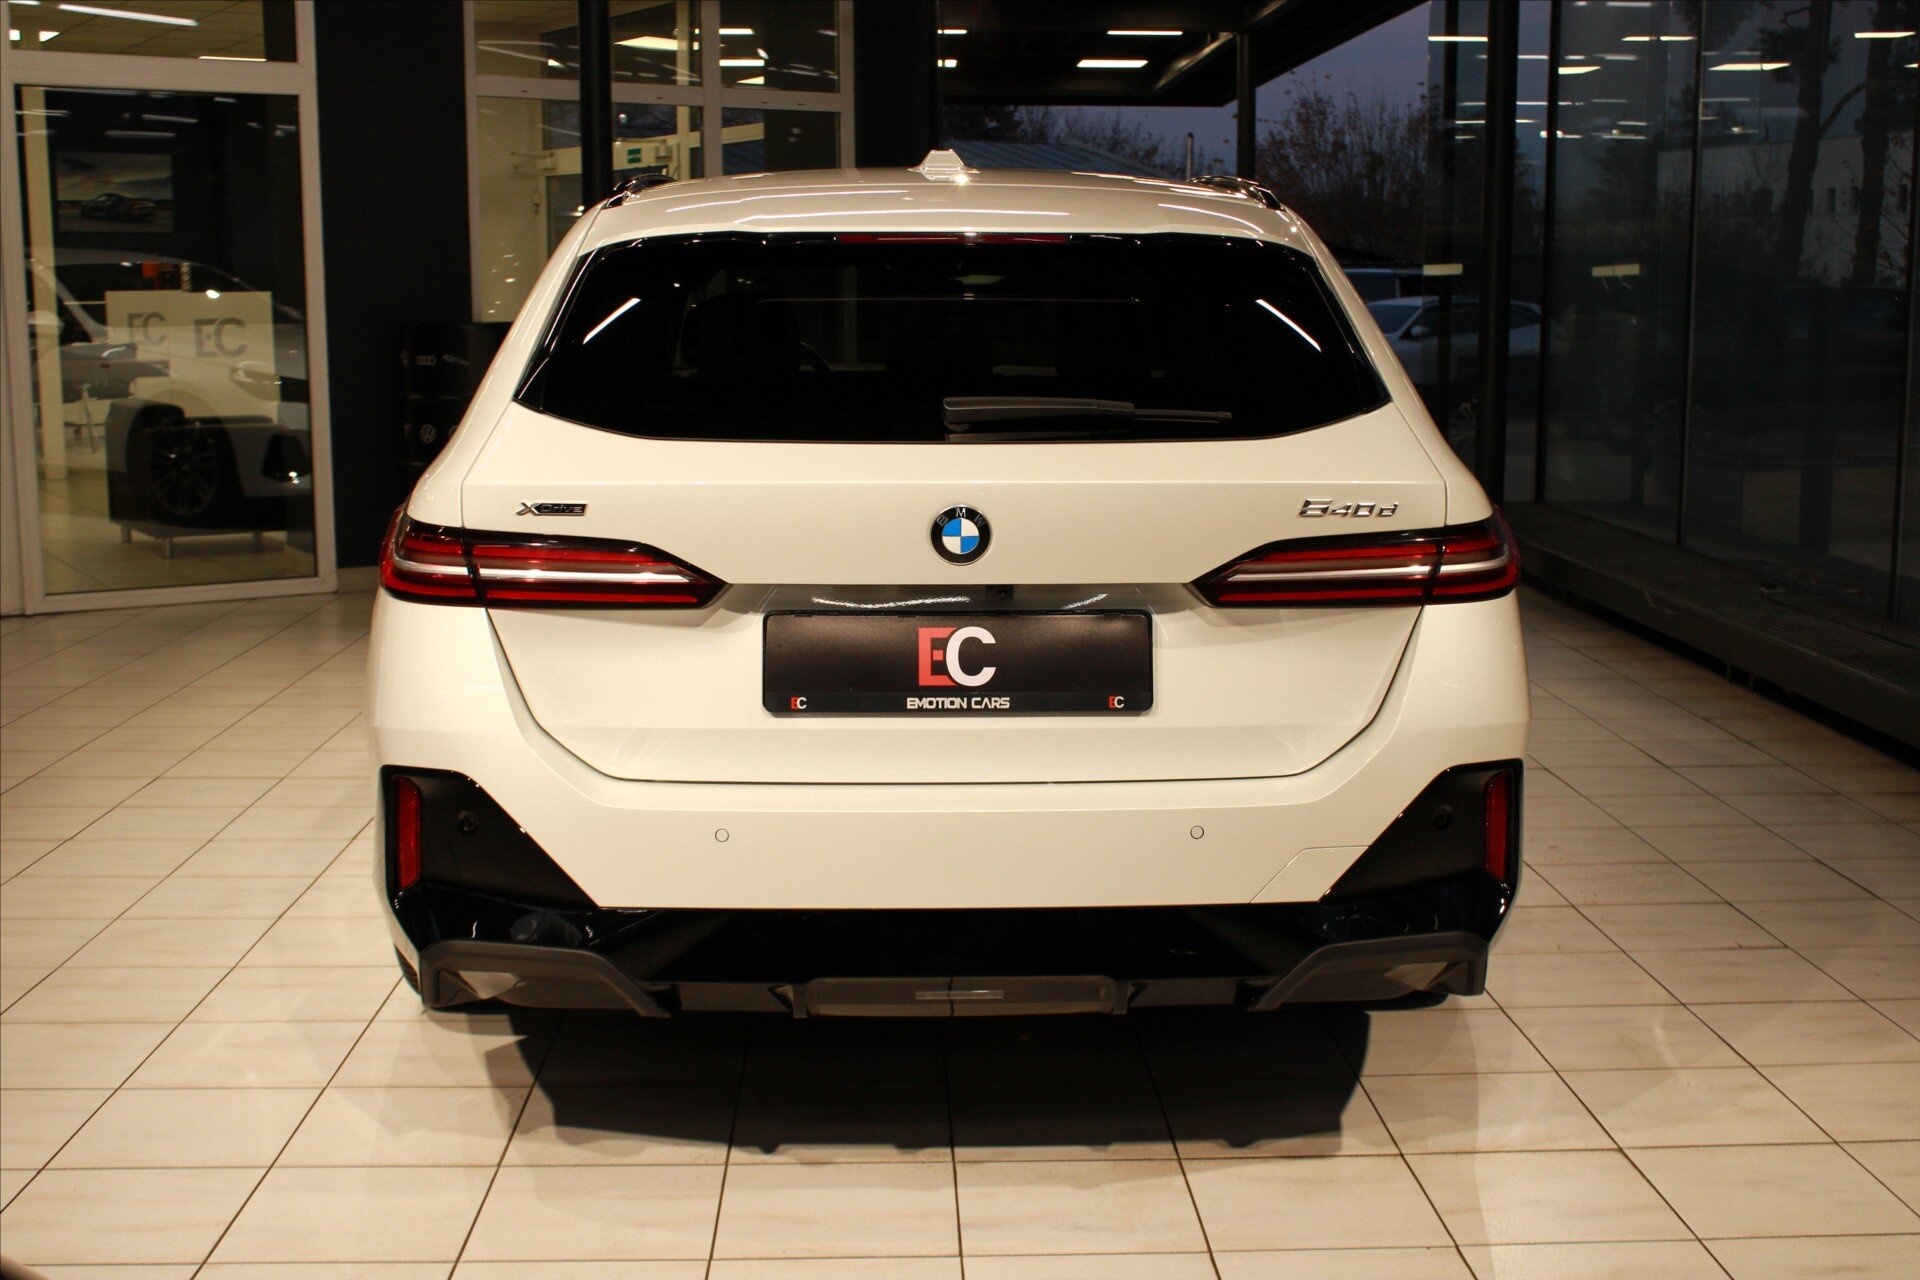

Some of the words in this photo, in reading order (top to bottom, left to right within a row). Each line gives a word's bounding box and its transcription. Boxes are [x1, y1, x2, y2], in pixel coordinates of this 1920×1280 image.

[194, 317, 248, 358] EC
[1298, 498, 1399, 517] 540d
[918, 626, 996, 686] EC
[791, 697, 807, 709] EC
[906, 697, 968, 710] EMOTION
[971, 697, 1010, 710] CARS
[1109, 696, 1124, 709] EC
